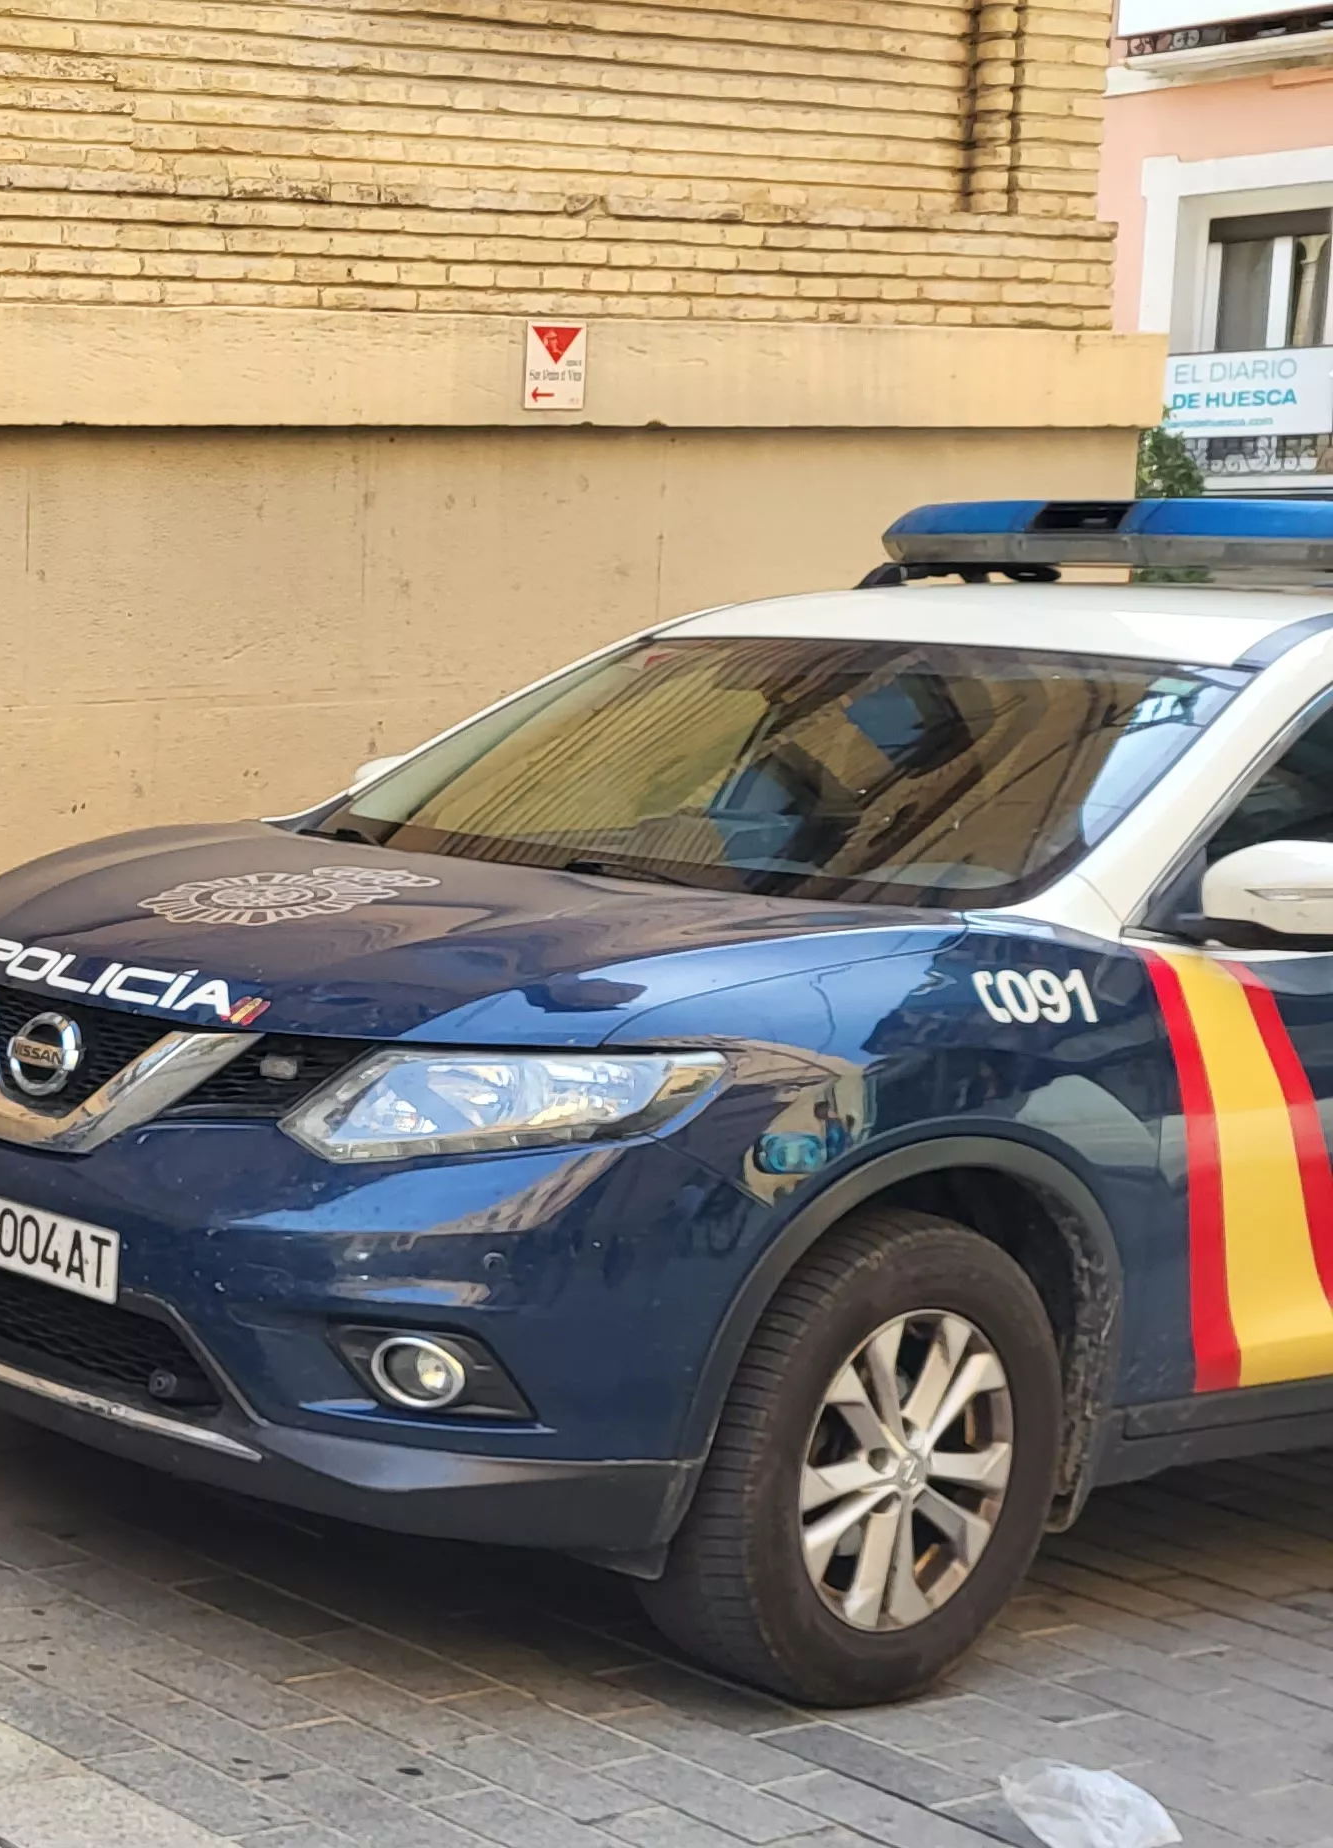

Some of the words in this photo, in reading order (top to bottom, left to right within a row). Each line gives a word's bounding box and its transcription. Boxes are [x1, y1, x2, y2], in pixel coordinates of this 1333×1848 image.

[1174, 363, 1203, 385] EL
[1209, 358, 1298, 383] DIARIO
[1171, 393, 1201, 410] DE
[1205, 388, 1298, 409] HUESCA
[994, 968, 1099, 1024] 091
[14, 1042, 63, 1065] NISSAN
